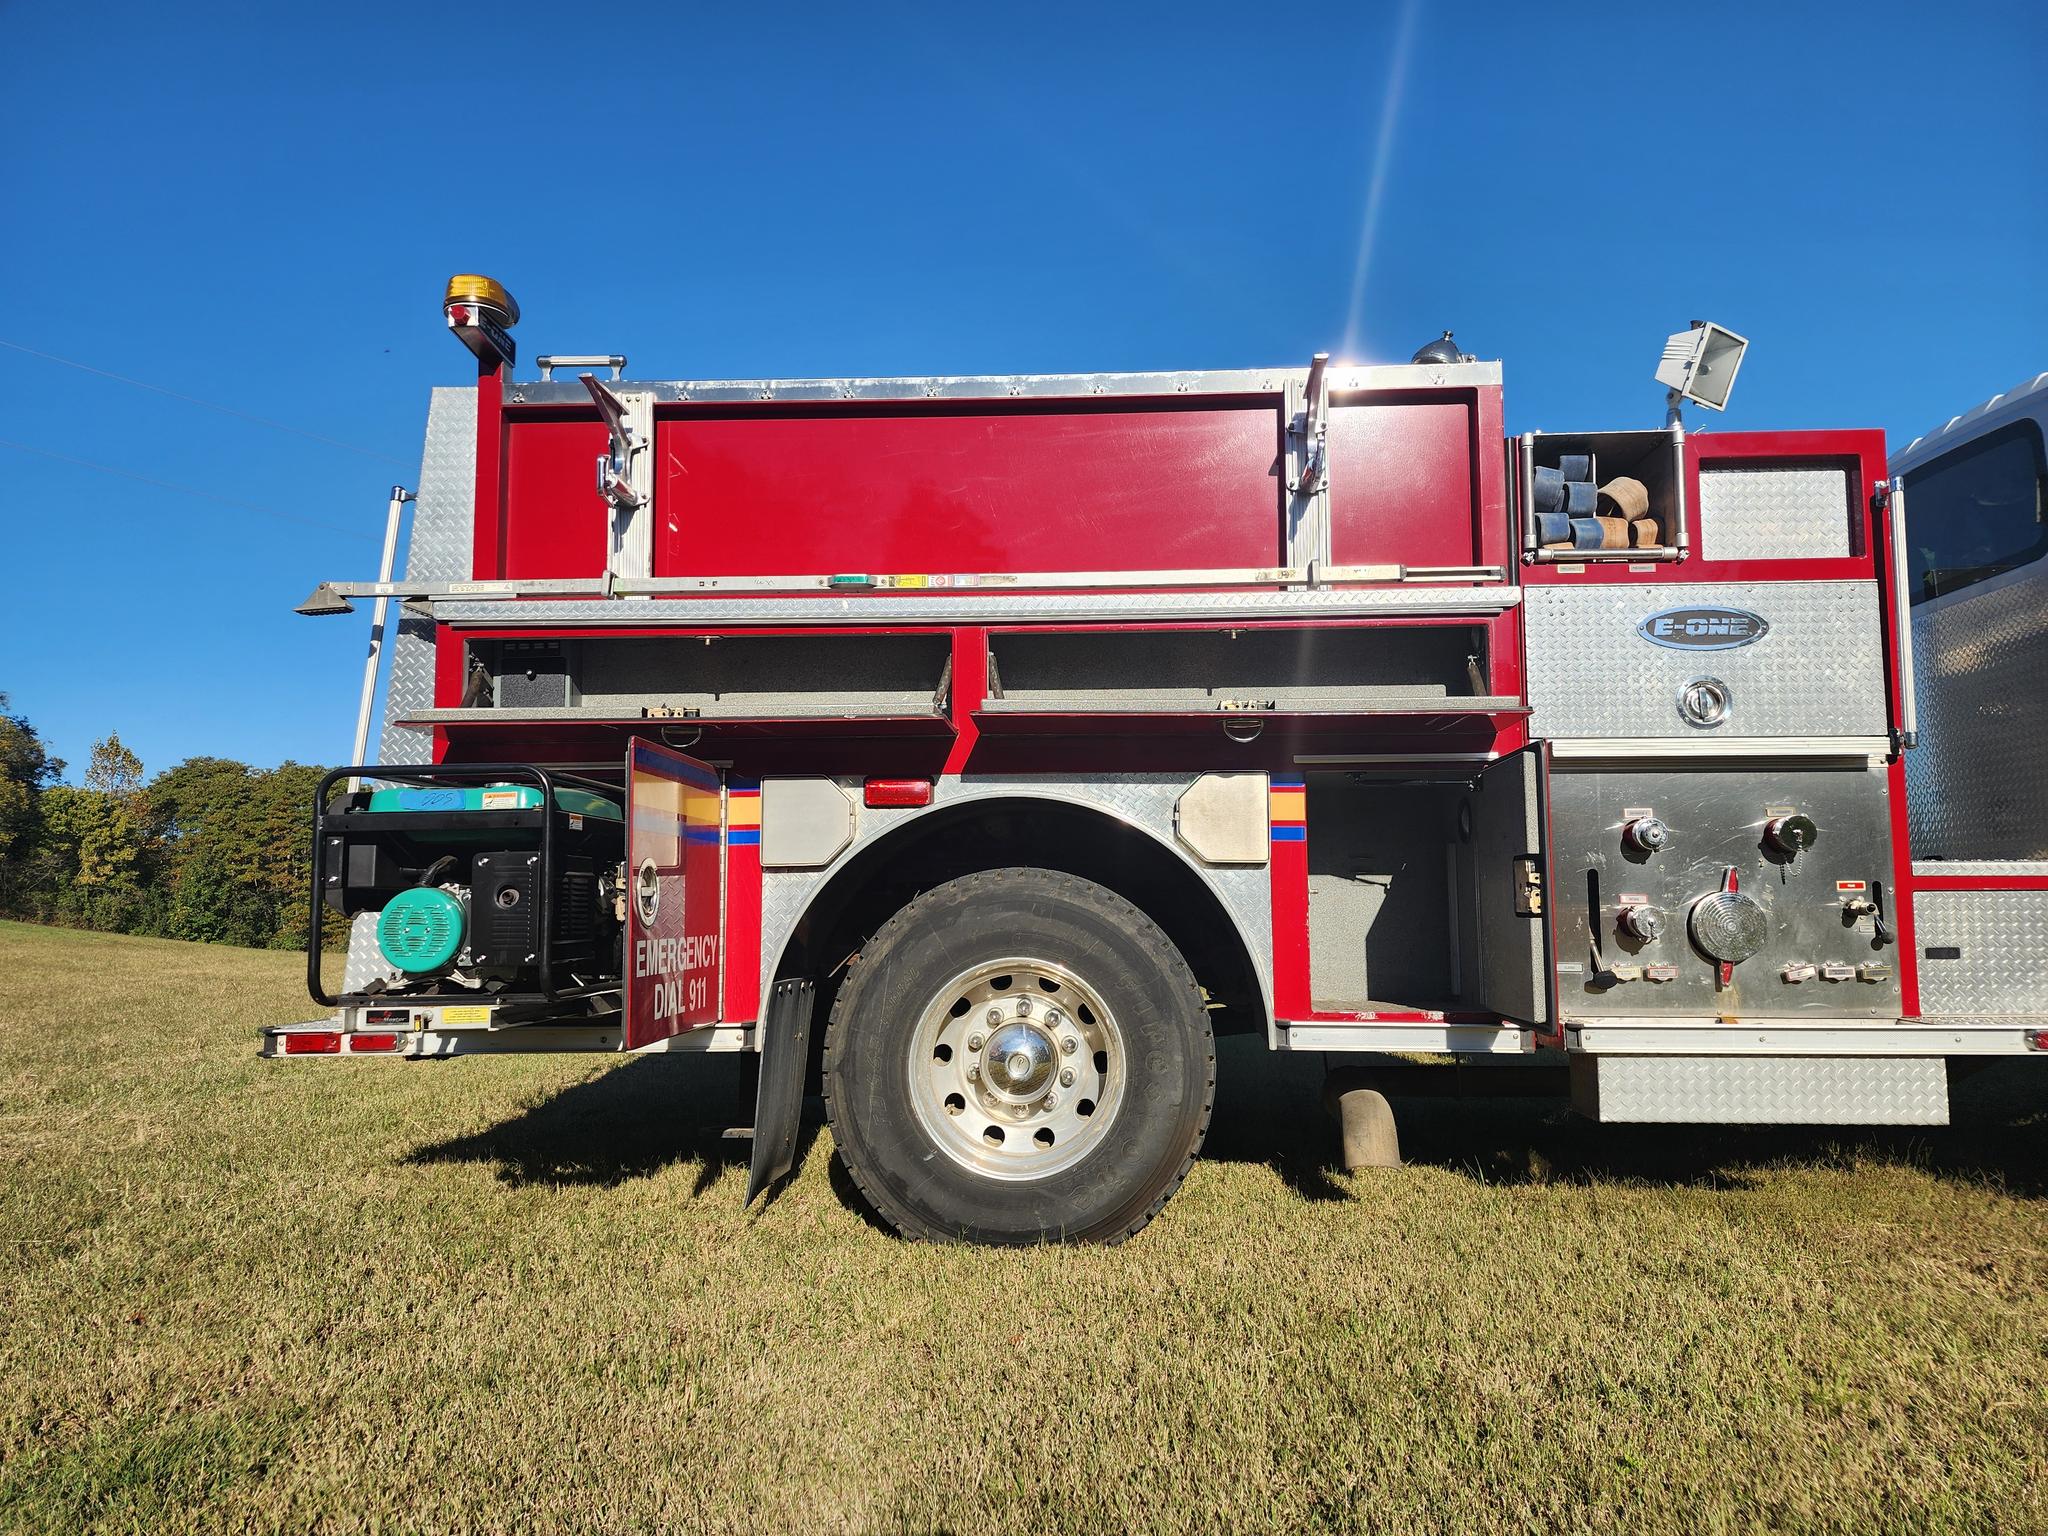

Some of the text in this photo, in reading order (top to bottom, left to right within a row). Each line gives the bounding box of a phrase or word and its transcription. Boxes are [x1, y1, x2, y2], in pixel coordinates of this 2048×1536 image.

[1654, 618, 1749, 636] E-ONE
[636, 934, 718, 978] EMERGENCY
[654, 976, 707, 1021] DIAL 911
